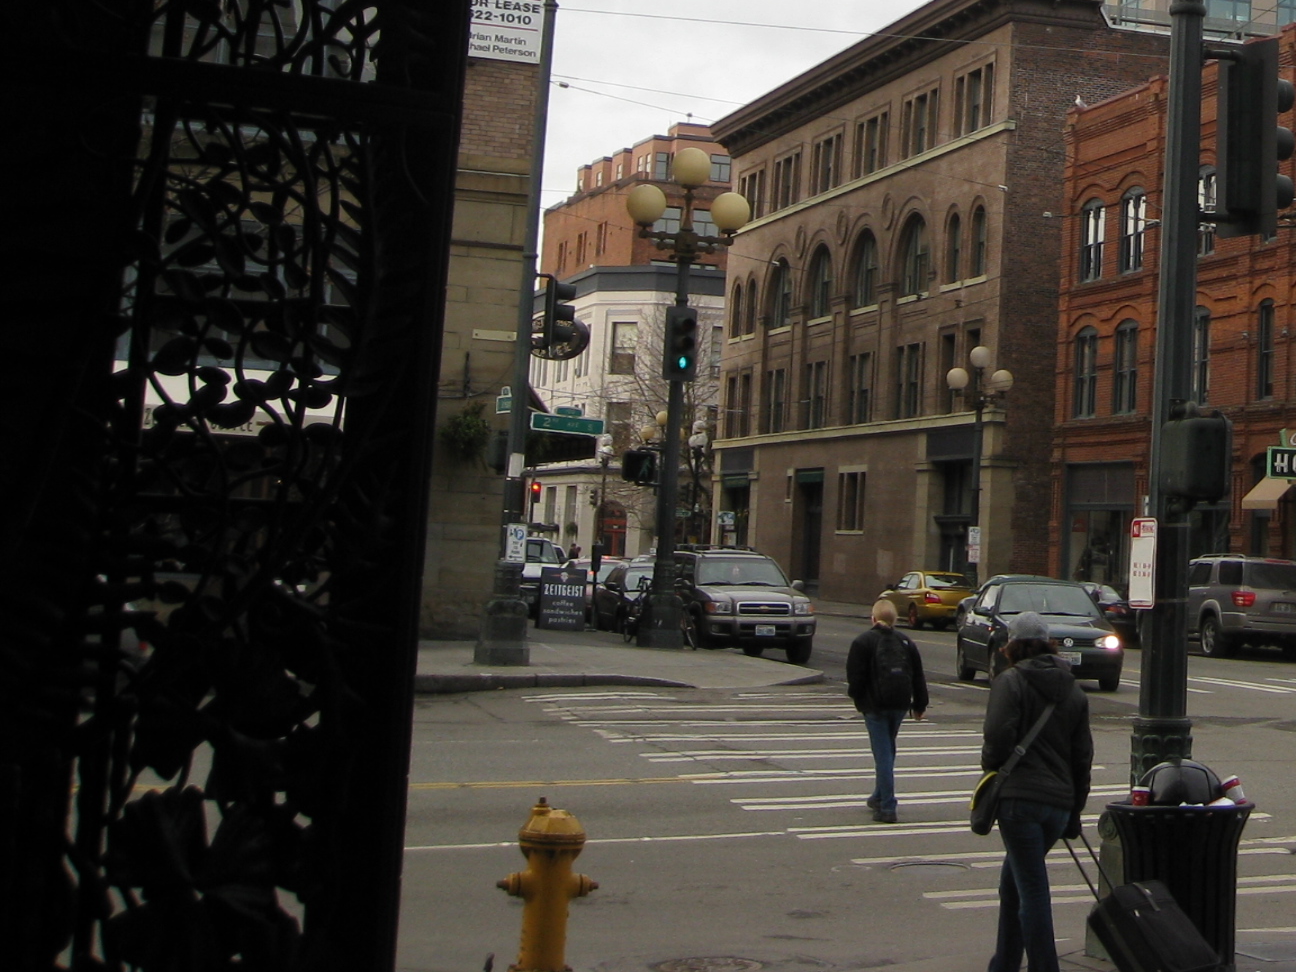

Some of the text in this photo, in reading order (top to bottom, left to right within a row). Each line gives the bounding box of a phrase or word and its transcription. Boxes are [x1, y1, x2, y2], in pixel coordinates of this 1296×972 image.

[495, 0, 541, 14] LEASE
[494, 34, 527, 46] Martin
[492, 44, 537, 58] Peterson
[544, 583, 584, 598] ZEITGEIST
[552, 599, 574, 607] coffee
